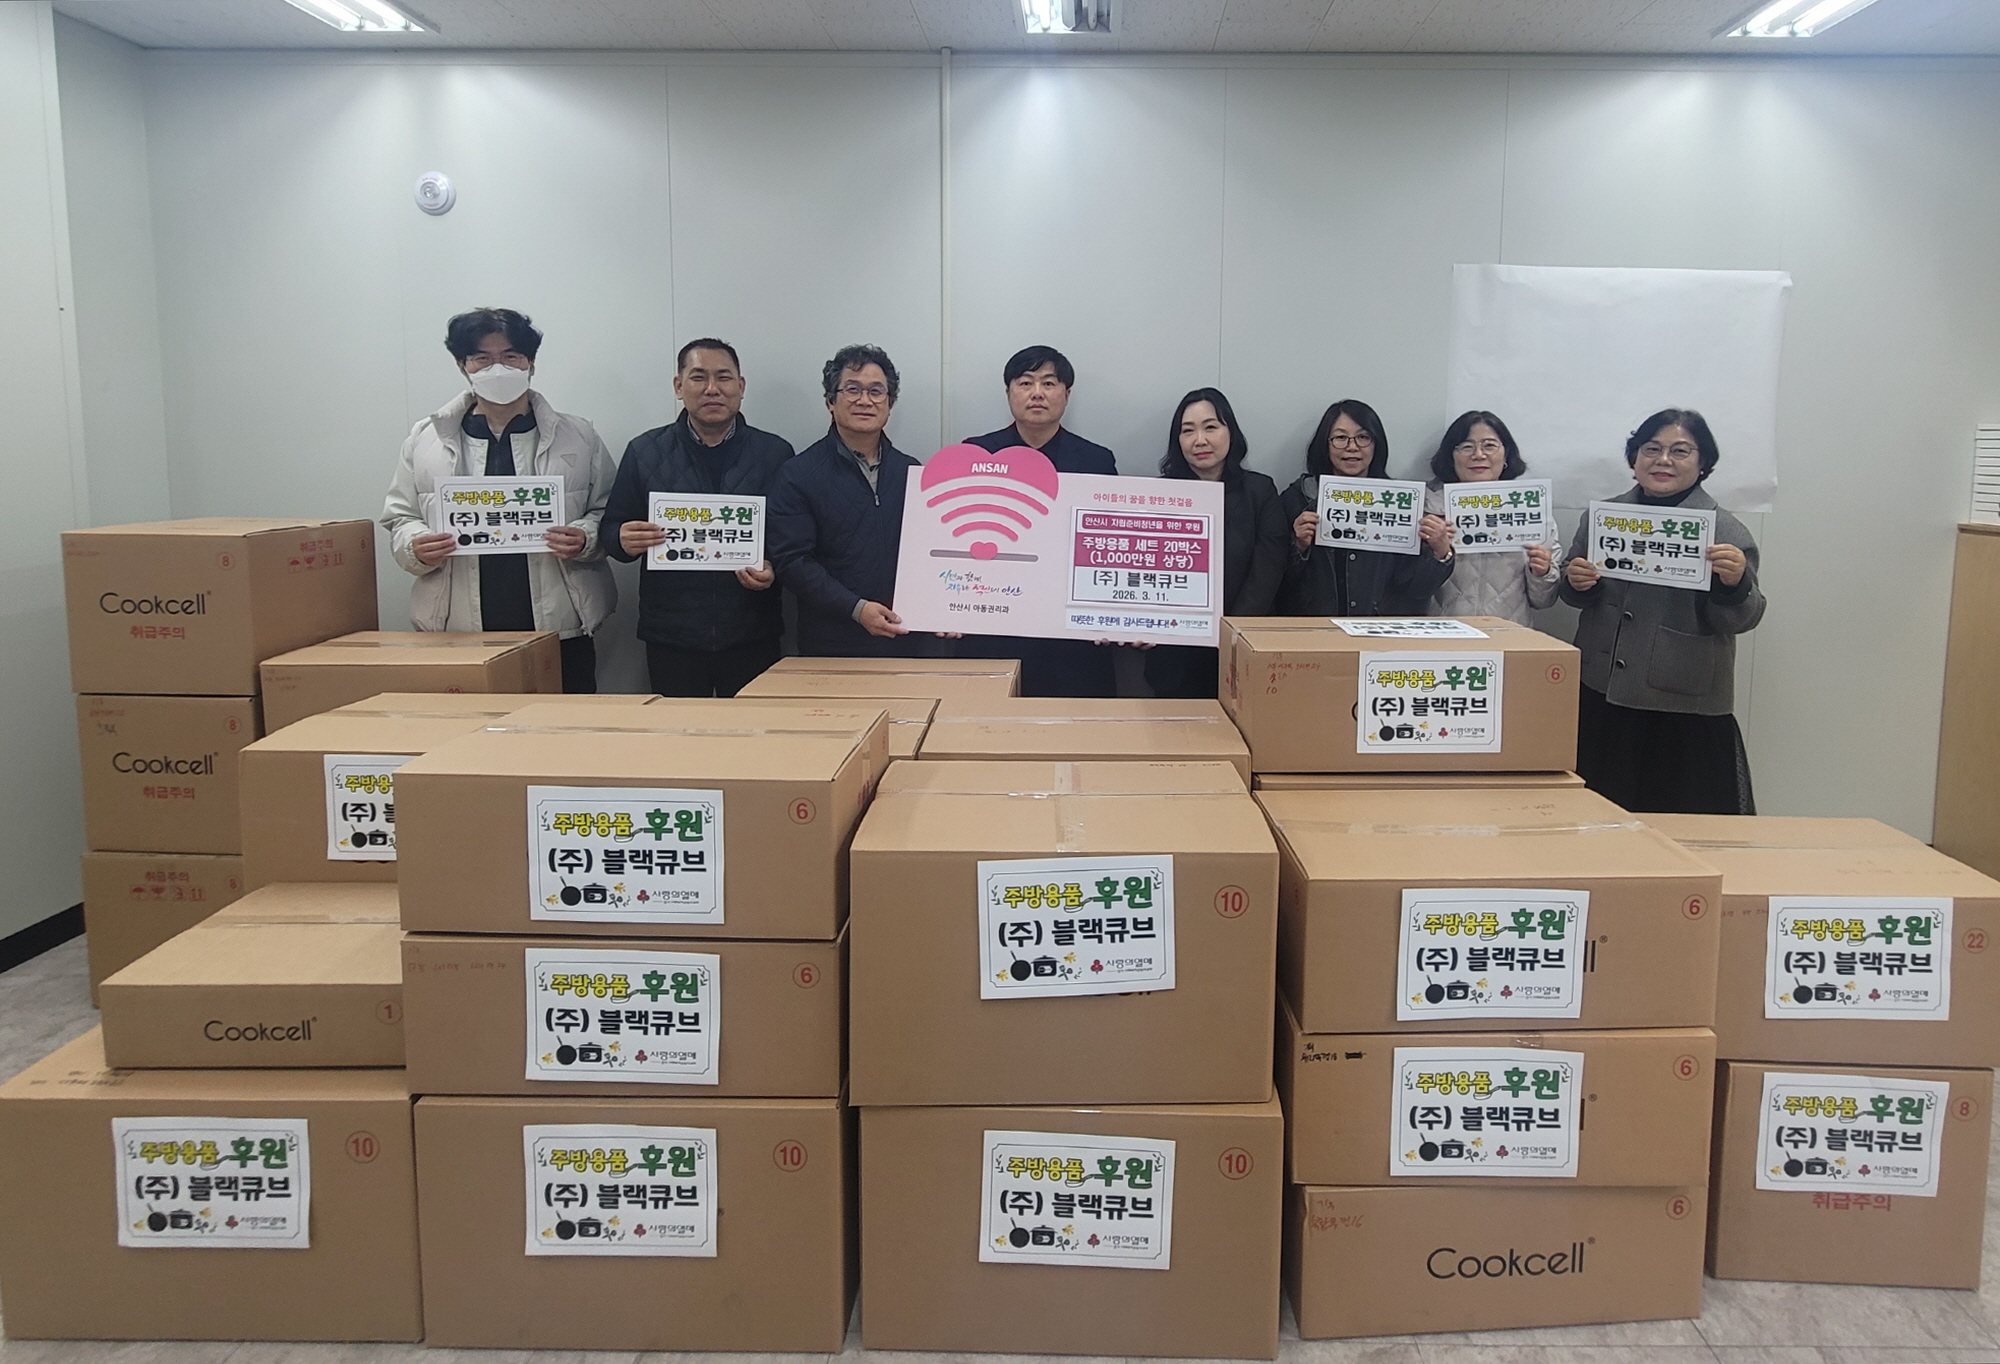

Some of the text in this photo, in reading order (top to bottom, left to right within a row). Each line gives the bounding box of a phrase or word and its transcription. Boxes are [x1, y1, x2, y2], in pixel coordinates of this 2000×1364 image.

[971, 463, 1008, 474] ANSAN
[452, 487, 551, 506] 주방용품 후원
[1094, 493, 1193, 507] 아이들의 꿈을 향한 첫걸음
[1331, 490, 1413, 510] 주방용품 후원
[1458, 490, 1539, 508] 주방용품 후원
[449, 511, 553, 527] (주) 블랙큐브
[664, 506, 753, 525] 주방용품 후원
[1085, 517, 1200, 531] 안산시 자립준비청년을 위한 후원
[1326, 508, 1412, 527] (주) 블랙큐브
[1455, 510, 1542, 527] (주) 블랙큐브
[692, 528, 753, 542] 블랙큐브
[1604, 517, 1701, 540] 주방용품 후원
[1083, 536, 1201, 554] 주방용품 세트 20박스
[1599, 536, 1700, 559] (주) 블랙큐브
[1090, 552, 1193, 569] (1,000만원 상당)
[1127, 572, 1188, 589] 블랙큐브
[1113, 590, 1169, 601] 2026. 3. 11.
[949, 603, 1009, 613] 안산시 아동권리과
[1071, 615, 1169, 628] 따뜻한 후원에 감사드립니다!
[130, 625, 186, 640] 취급주의
[1377, 666, 1487, 690] 주방용품 후원
[1372, 697, 1405, 716] (주)
[1411, 697, 1488, 716] 블랙큐브
[143, 785, 195, 800] 취급주의
[345, 774, 394, 794] 주방용
[342, 803, 376, 822] (주)
[553, 808, 703, 842] 주방용품 후원
[548, 848, 706, 875] (주) 블랙큐브
[652, 890, 699, 901] 사랑의열매
[1003, 875, 1152, 909] 주방용품 후원
[998, 916, 1156, 947] (주) 블랙큐브
[1423, 908, 1565, 940] 주방용품 후원
[1791, 915, 1932, 946] 주방용품 후원
[1105, 956, 1152, 969] 사랑의열매
[1415, 947, 1458, 972] (주)
[1466, 947, 1566, 972] 블랙큐브
[1784, 951, 1933, 975] (주) 블랙큐브
[551, 969, 700, 1004] 주방용품 후원
[1515, 985, 1560, 996] 사랑의열매
[545, 1008, 701, 1035] (주) 블랙큐브
[650, 1050, 697, 1061] 사랑의열매
[1416, 1067, 1559, 1100] 주방용품 후원
[1409, 1106, 1452, 1130] (주)
[1460, 1107, 1561, 1132] 블랙큐브
[1783, 1095, 1924, 1125] 주방용품 후원
[1775, 1126, 1923, 1152] (주) 블랙큐브
[139, 1137, 289, 1169] 주방용품 후원
[1511, 1145, 1556, 1156] 사랑의열매
[550, 1145, 696, 1177] 주방용품 후원
[1007, 1156, 1153, 1189] 주방용품 후원
[135, 1175, 292, 1201] (주) 블랙큐브
[544, 1182, 699, 1209] (주) 블랙큐브
[1000, 1190, 1154, 1220] (주) 블랙큐브
[1812, 1193, 1892, 1212] 취급주의
[1103, 1234, 1149, 1246] 사랑의열매
